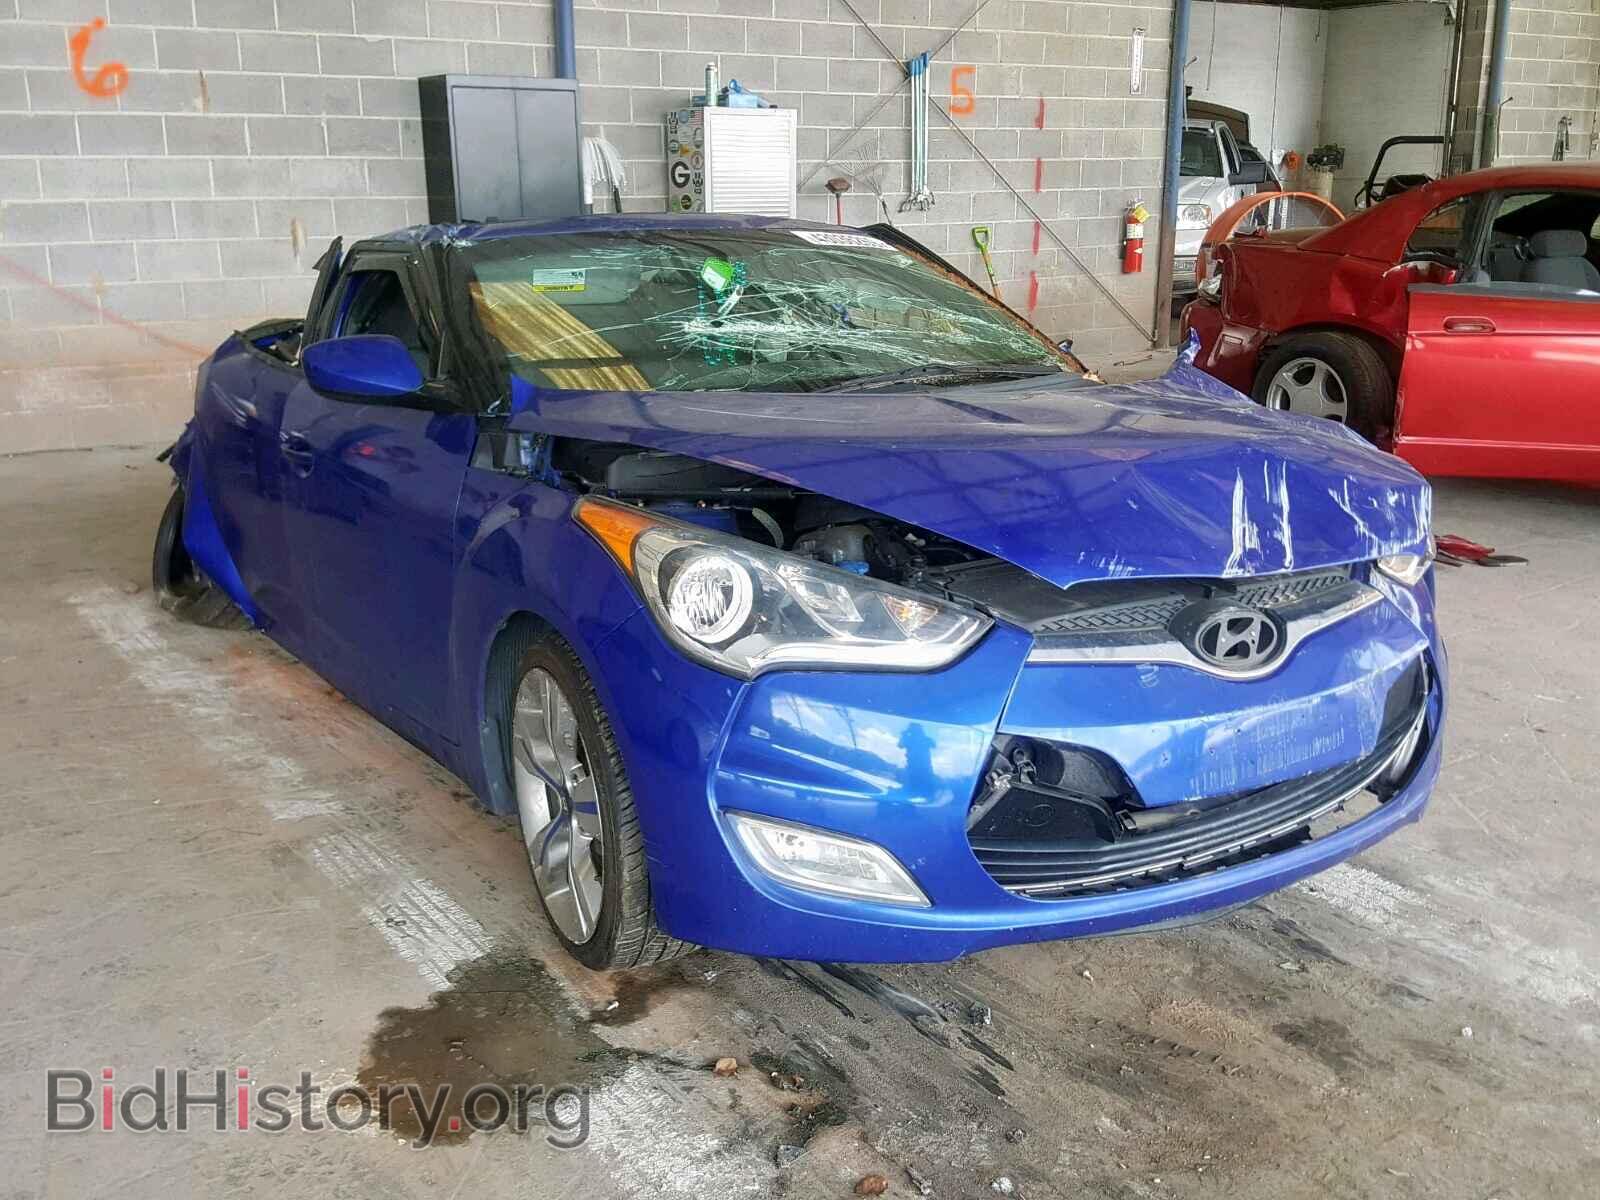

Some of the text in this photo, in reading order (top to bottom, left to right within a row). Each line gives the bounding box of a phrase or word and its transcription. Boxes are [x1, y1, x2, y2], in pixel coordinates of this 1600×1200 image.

[70, 16, 129, 97] 6
[948, 65, 976, 115] 5
[670, 161, 691, 189] G
